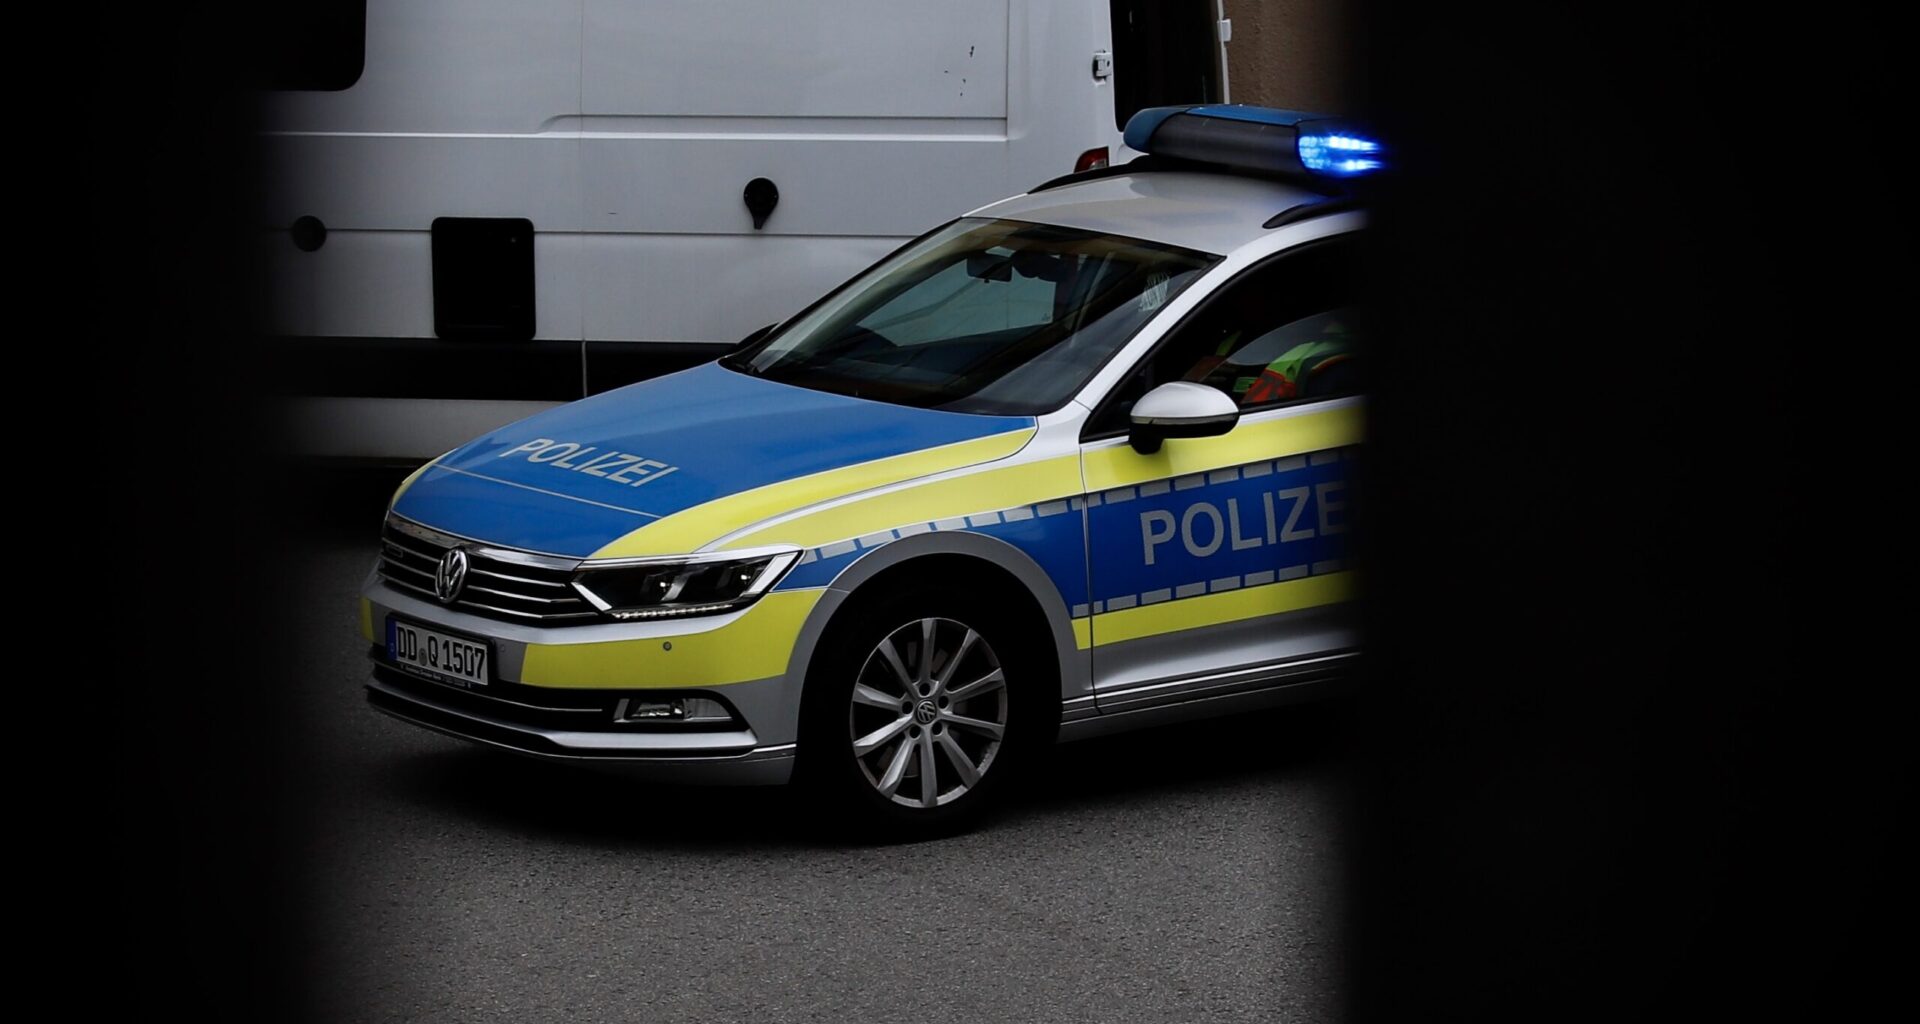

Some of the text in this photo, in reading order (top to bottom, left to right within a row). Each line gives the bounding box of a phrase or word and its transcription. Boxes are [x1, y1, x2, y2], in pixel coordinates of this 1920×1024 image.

[498, 438, 680, 487] POLIZEI
[1139, 480, 1350, 566] POLIZE
[397, 626, 417, 660] DD
[428, 636, 438, 667] Q
[443, 640, 485, 679] 1507
